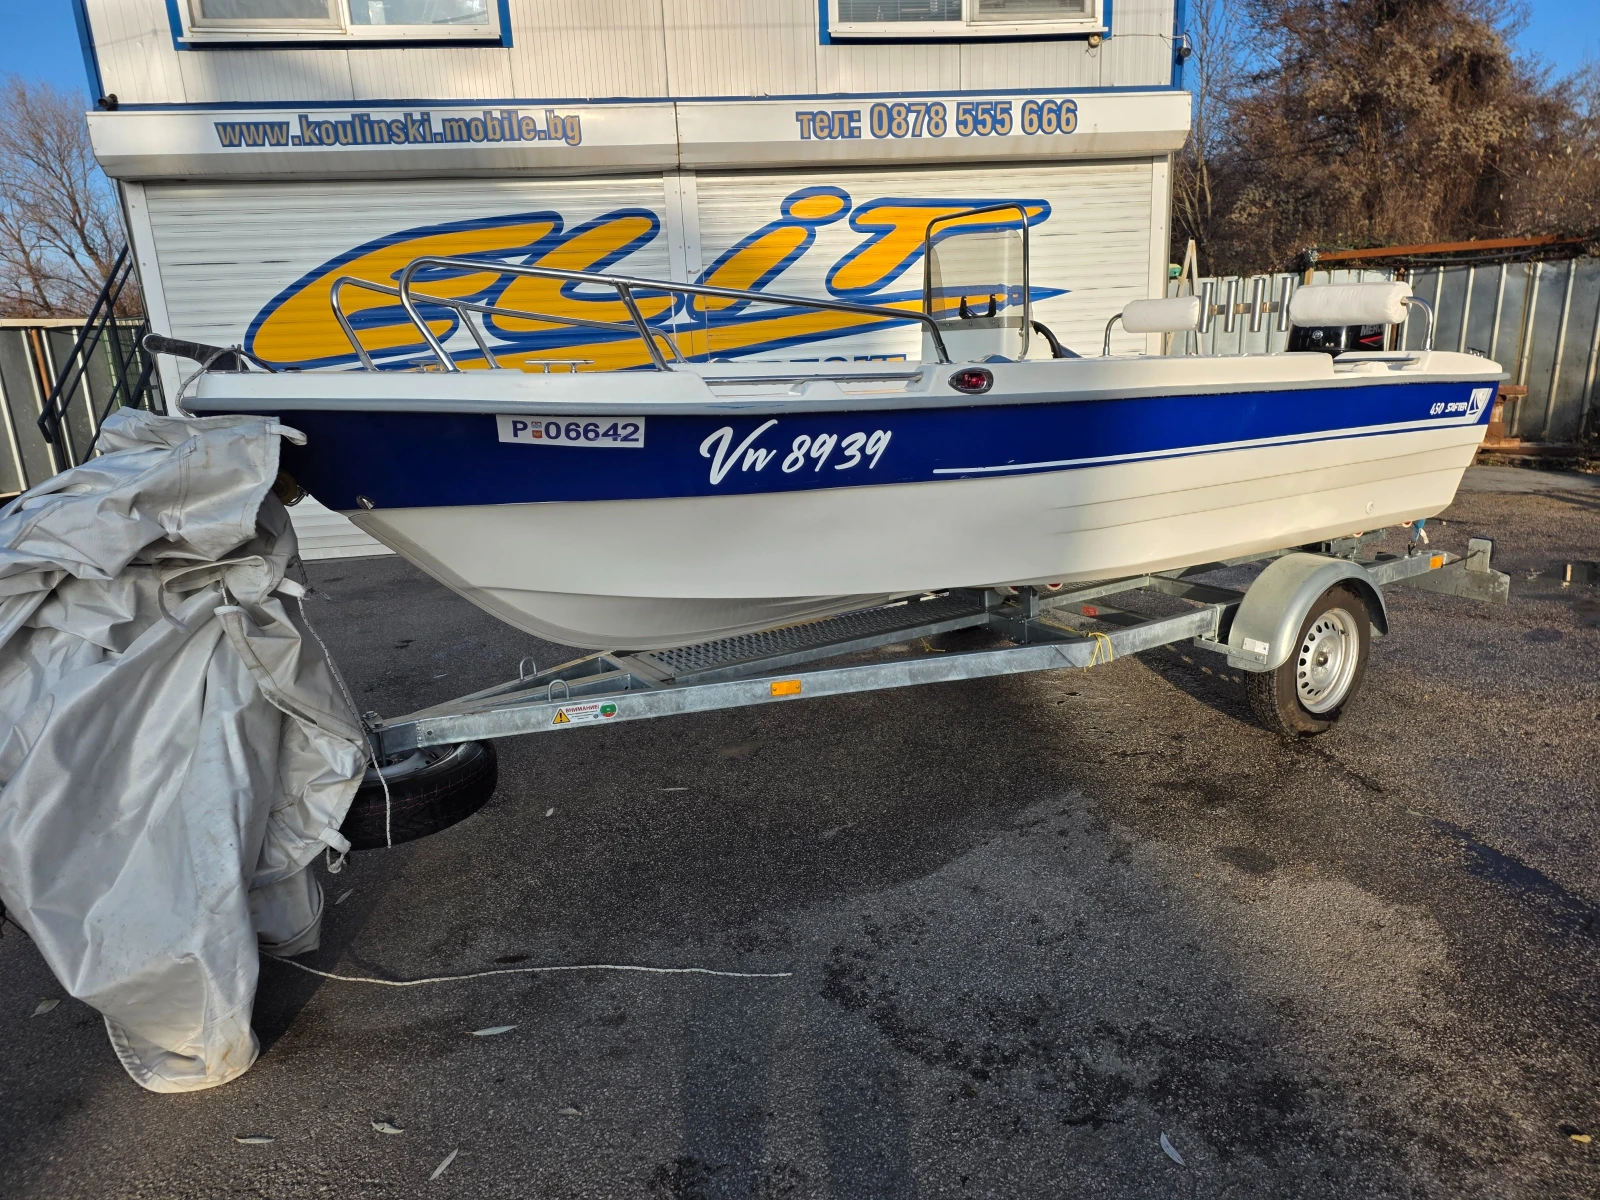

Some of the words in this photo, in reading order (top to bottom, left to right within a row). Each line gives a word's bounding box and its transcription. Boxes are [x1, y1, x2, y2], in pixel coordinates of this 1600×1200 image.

[214, 110, 582, 146] www.koulinski.mobile.bg
[796, 110, 861, 139] тел:
[870, 102, 947, 139] 0878
[956, 101, 1013, 137] 555
[1021, 99, 1078, 135] 666
[511, 420, 528, 438] P
[544, 421, 640, 442] 06642
[781, 429, 892, 473] 8939
